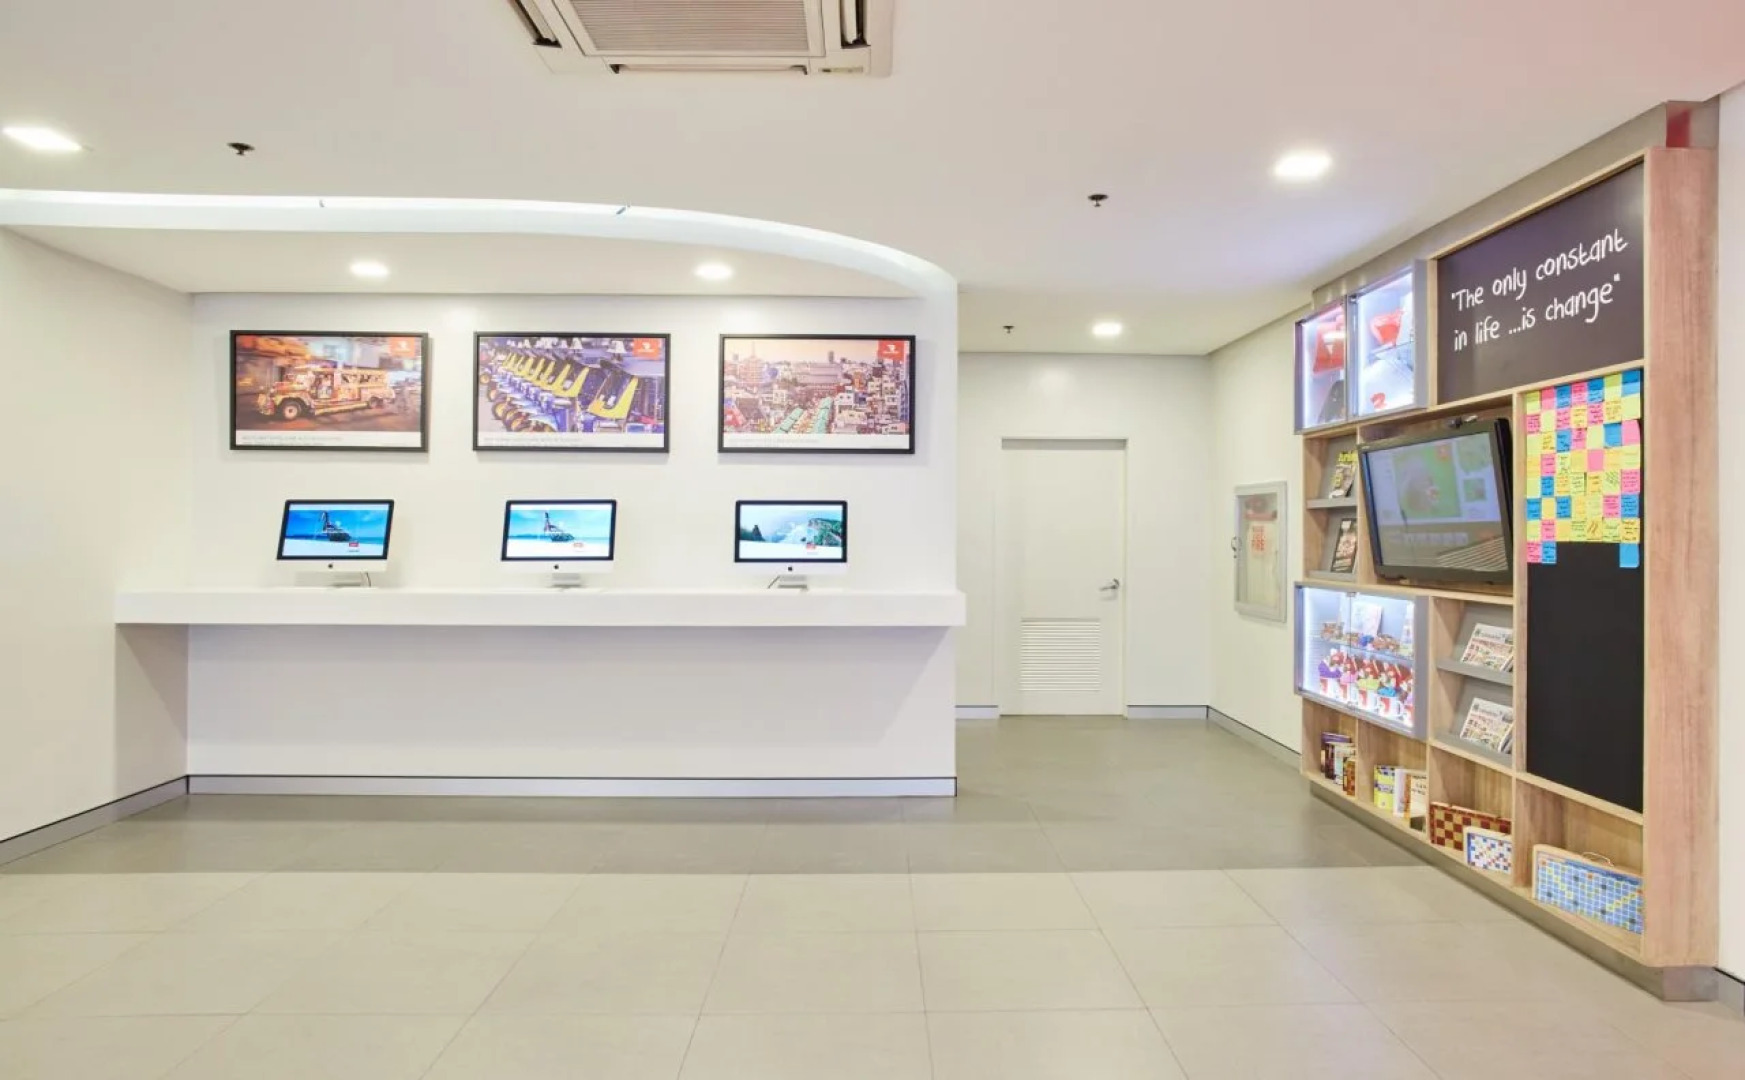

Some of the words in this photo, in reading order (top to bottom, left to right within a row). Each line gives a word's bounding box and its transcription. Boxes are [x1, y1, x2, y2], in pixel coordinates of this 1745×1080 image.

[1492, 267, 1527, 301] only
[1535, 228, 1629, 281] constant
[1454, 329, 1467, 352] in
[1475, 315, 1500, 345] life
[1545, 272, 1621, 324] change"
